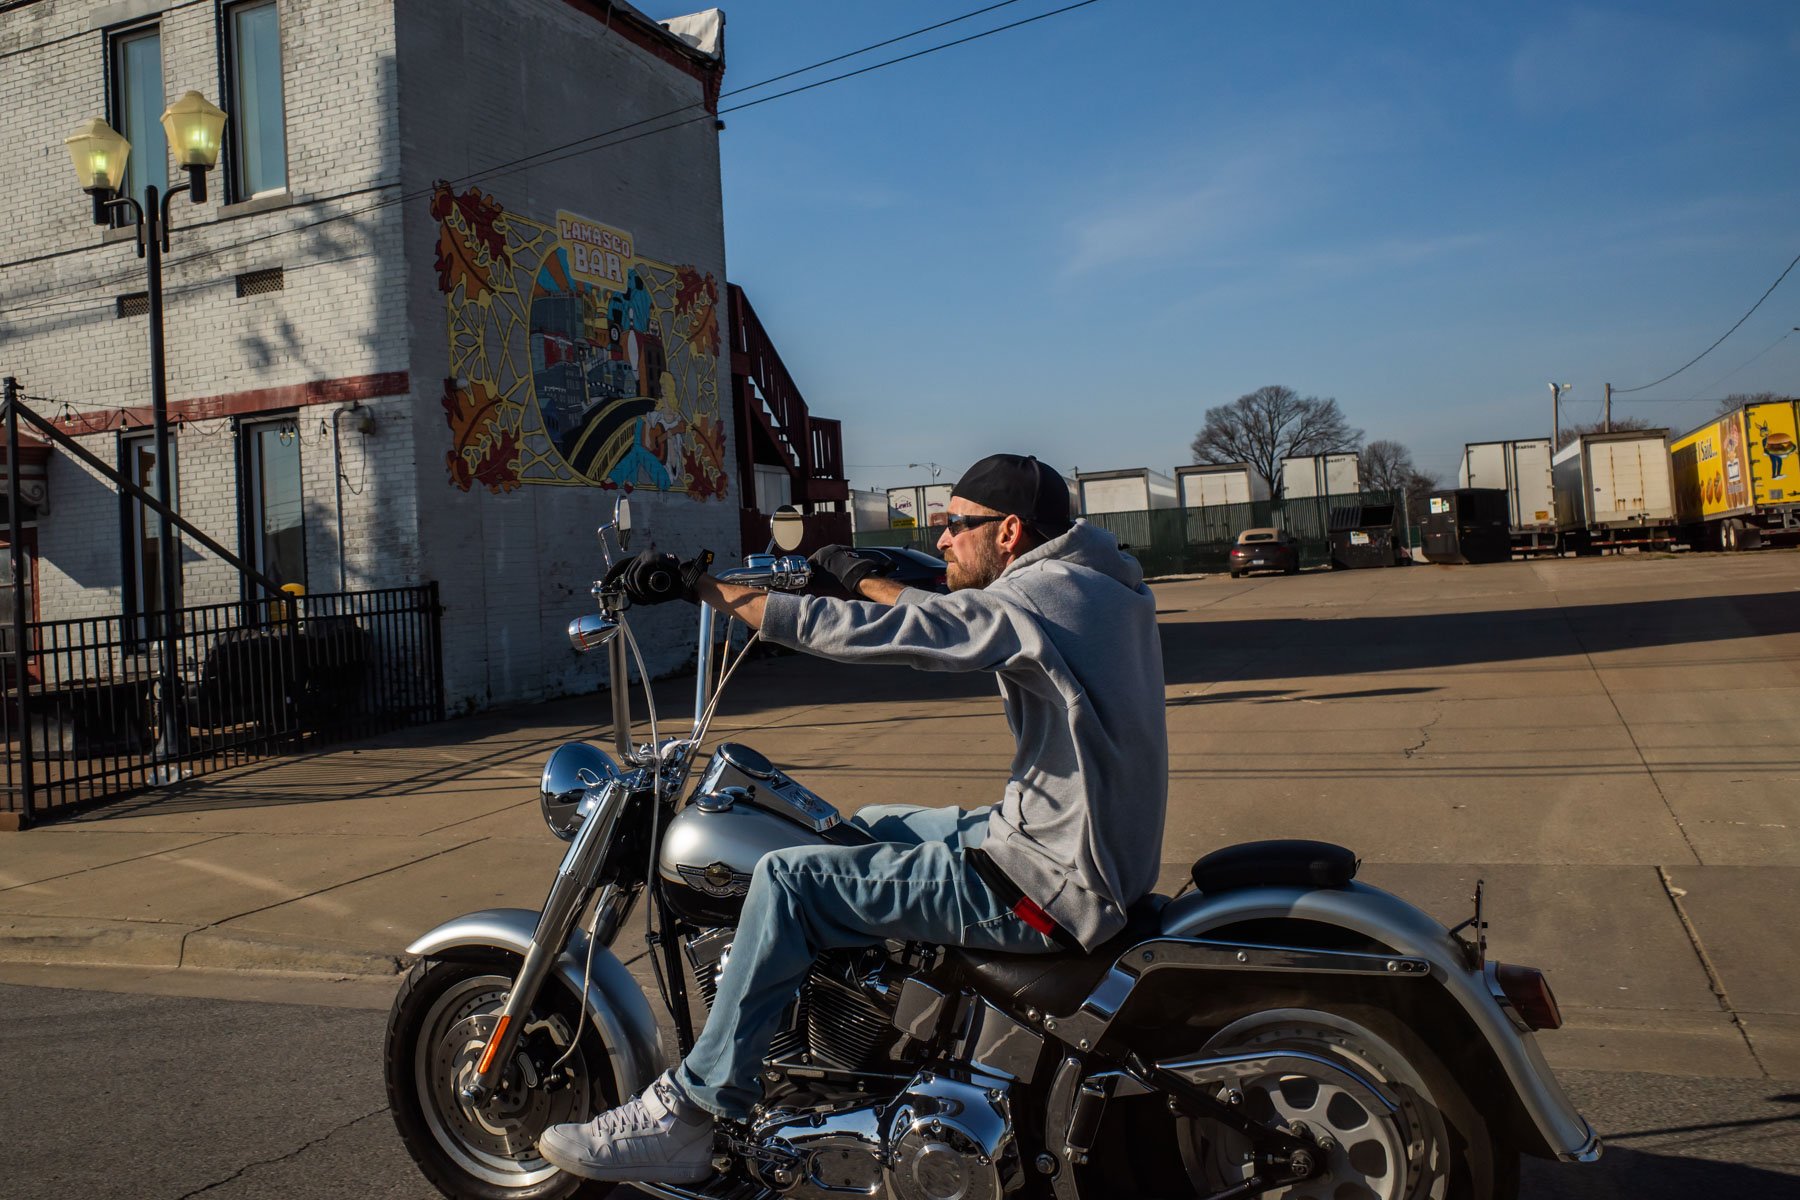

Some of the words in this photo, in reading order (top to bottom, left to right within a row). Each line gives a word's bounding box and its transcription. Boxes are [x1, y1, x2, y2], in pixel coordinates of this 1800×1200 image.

[560, 220, 630, 259] LAMASCO
[573, 242, 624, 283] BAR
[895, 501, 912, 510] Lewis
